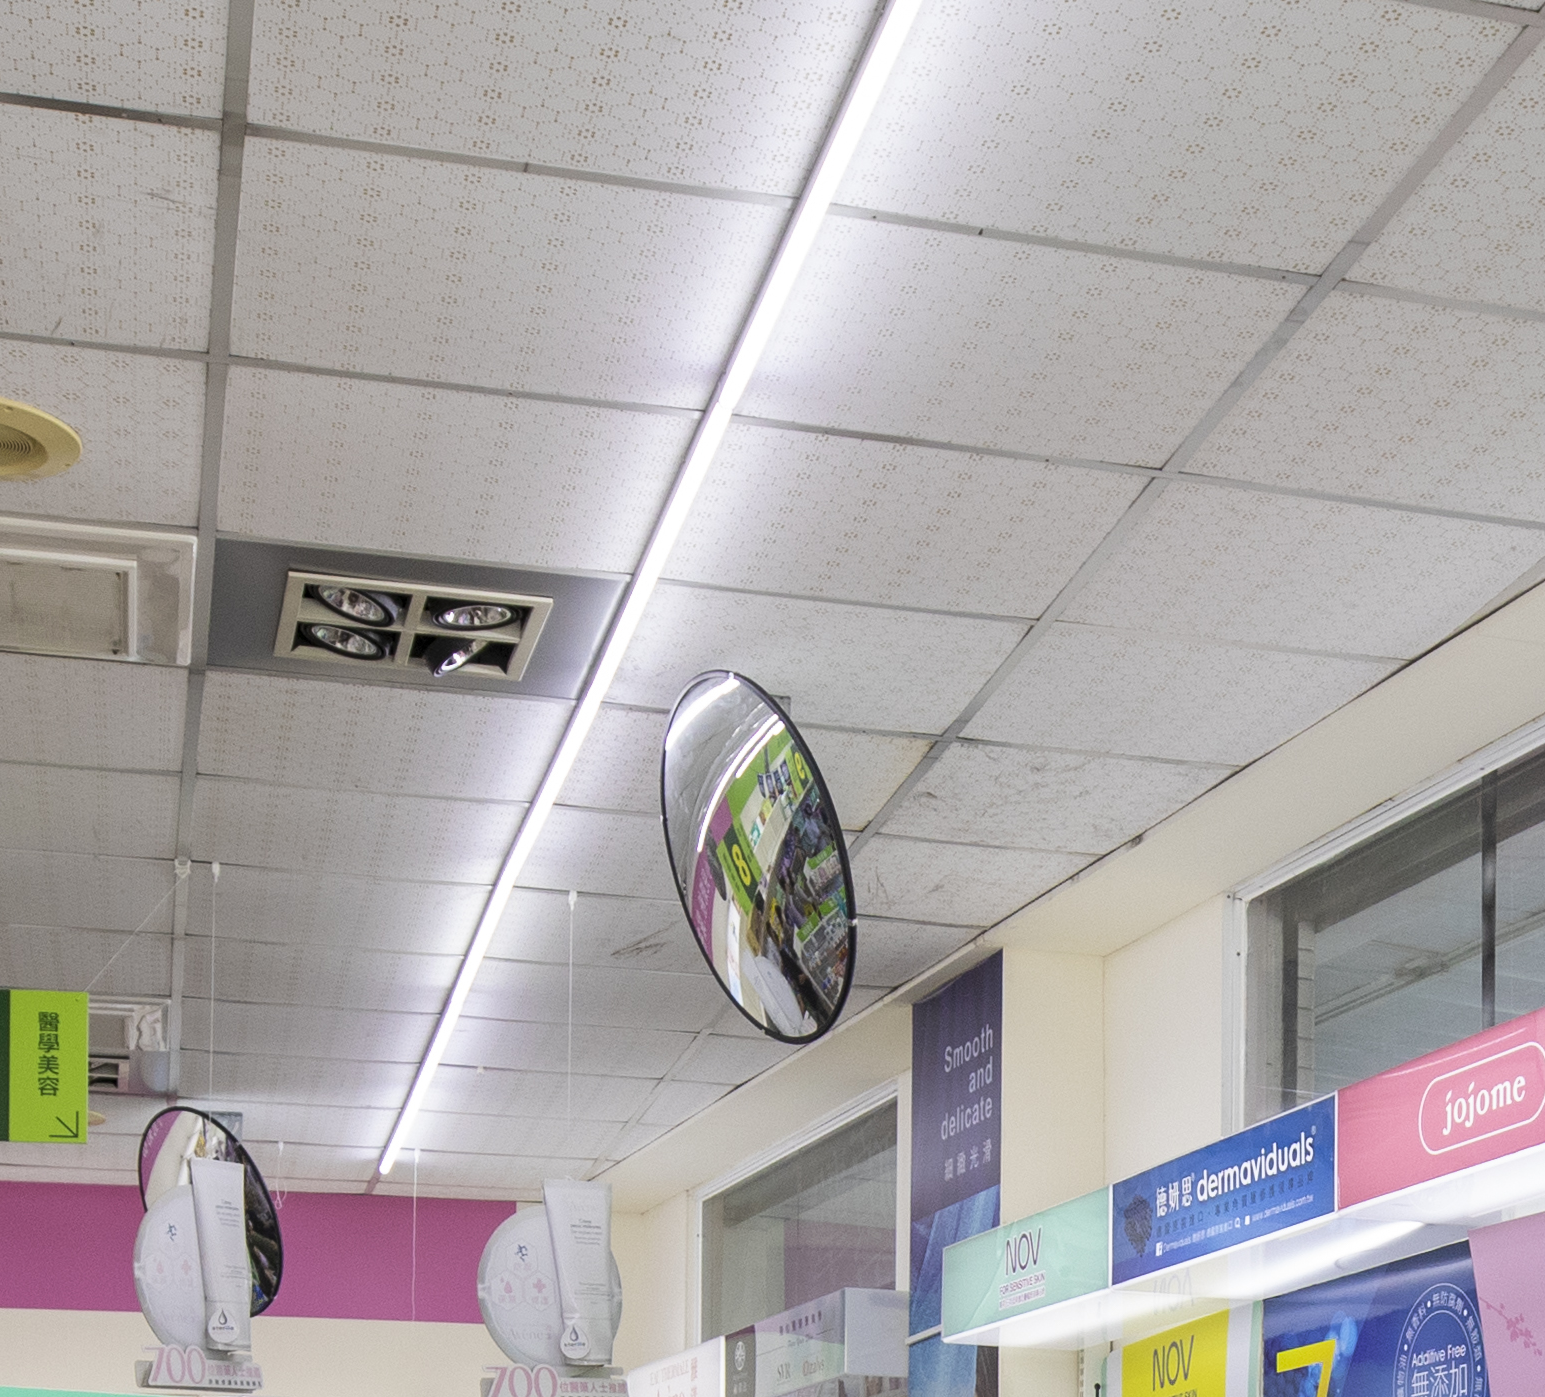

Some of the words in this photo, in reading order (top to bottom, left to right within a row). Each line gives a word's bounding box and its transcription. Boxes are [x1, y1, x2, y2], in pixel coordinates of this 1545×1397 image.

[37, 1010, 61, 1098] 醫學美容
[943, 1025, 994, 1071] Smooth
[968, 1057, 994, 1094] and
[941, 1098, 993, 1140] delicate
[1442, 1071, 1526, 1136] jojome
[1197, 1132, 1314, 1201] dermaviduals
[1005, 1228, 1042, 1275] NOV
[1152, 1335, 1194, 1391] NOV
[1412, 1351, 1445, 1368] Additive
[1447, 1344, 1466, 1357] Free
